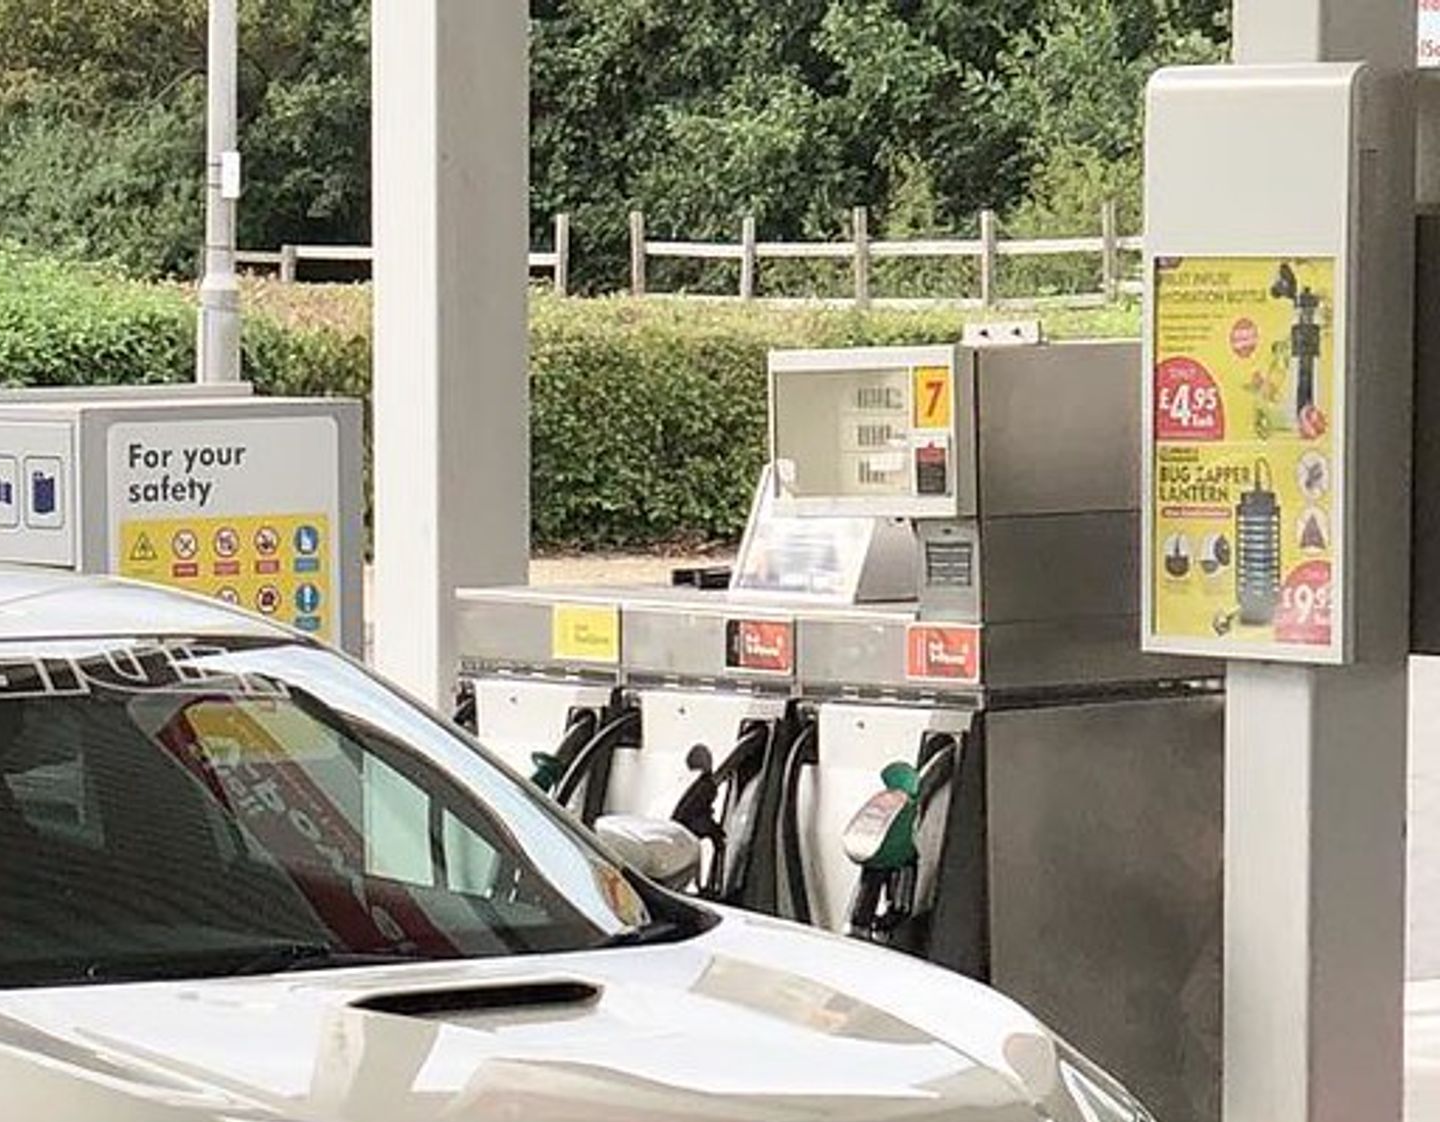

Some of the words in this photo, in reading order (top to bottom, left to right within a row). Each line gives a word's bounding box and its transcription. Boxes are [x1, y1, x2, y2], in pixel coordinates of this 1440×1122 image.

[925, 381, 944, 418] 7
[127, 443, 173, 469] For
[183, 446, 247, 473] your
[127, 475, 213, 507] safety
